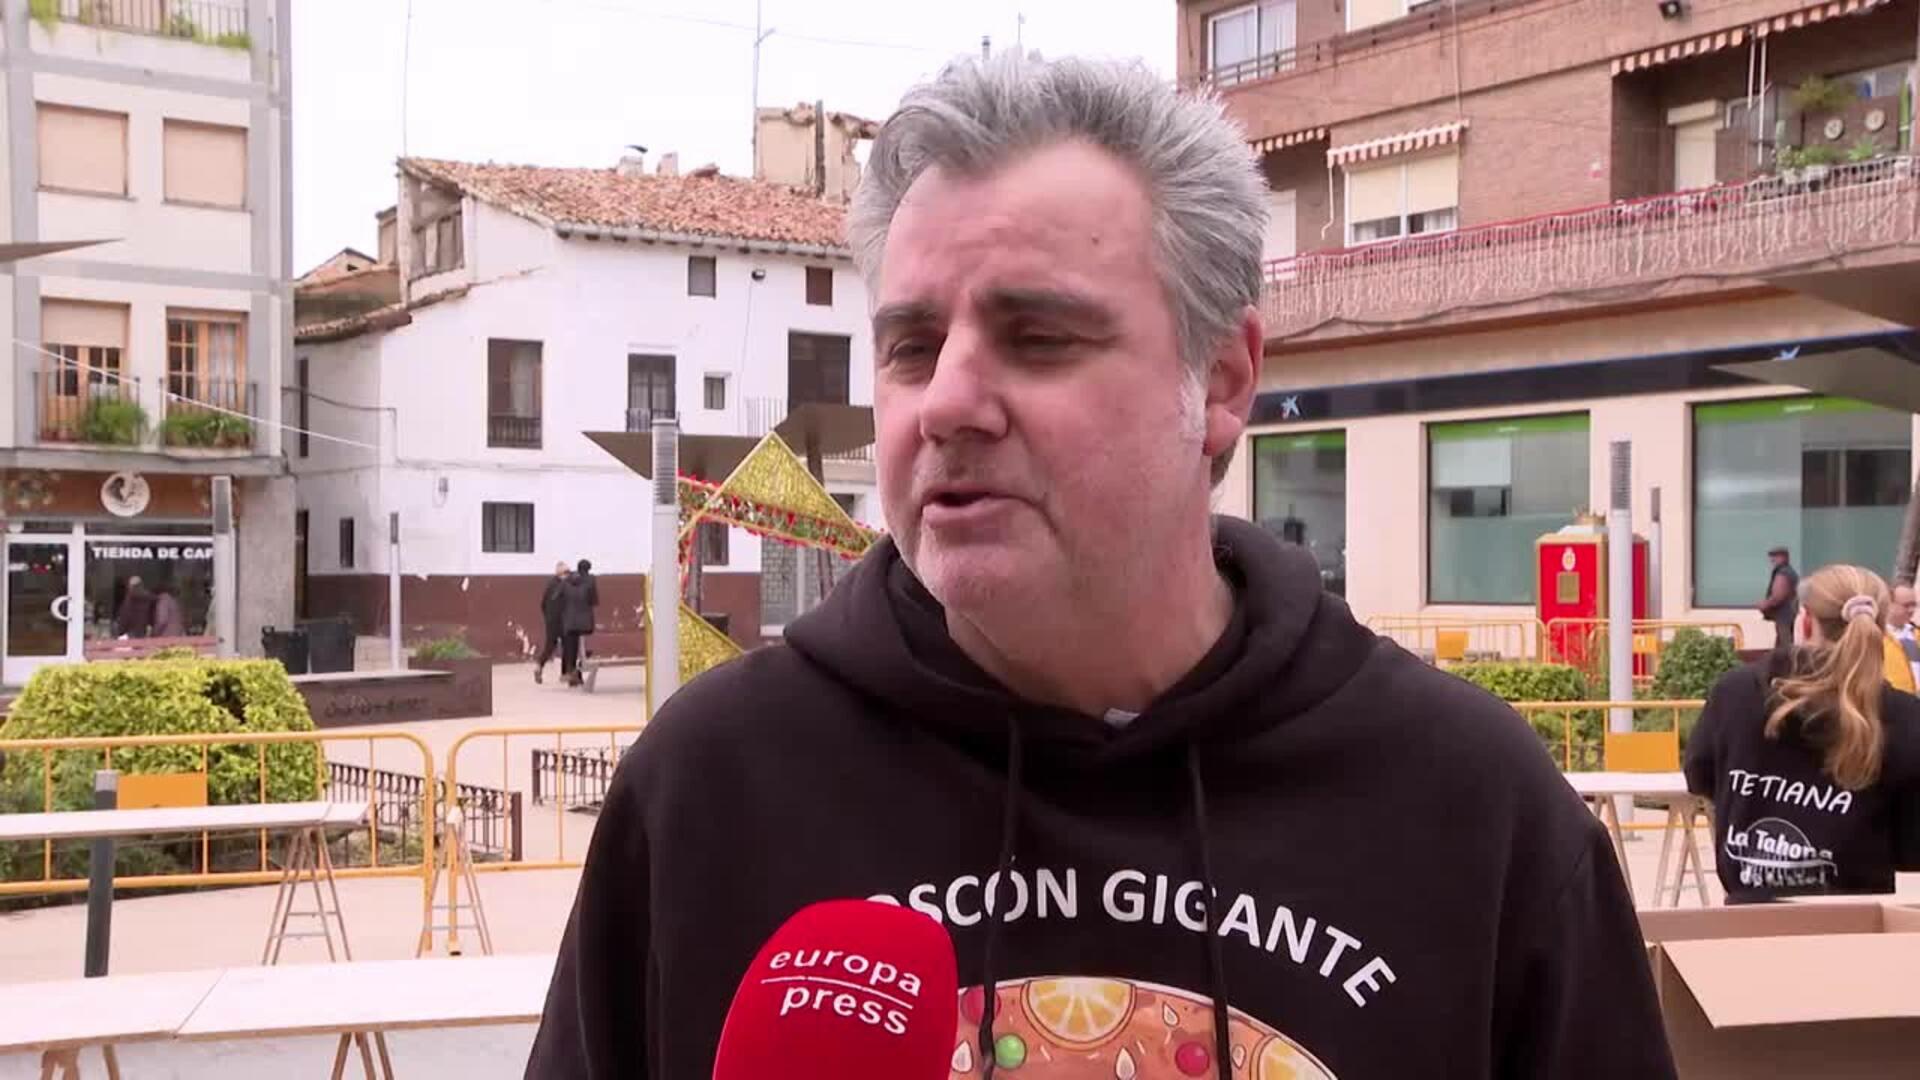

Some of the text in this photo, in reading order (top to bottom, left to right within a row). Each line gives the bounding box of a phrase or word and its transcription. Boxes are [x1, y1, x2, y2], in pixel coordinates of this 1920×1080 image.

[93, 546, 153, 559] TIENDA
[158, 547, 179, 559] DE
[1728, 769, 1853, 814] TETIANA
[1727, 824, 1748, 848] La
[1102, 869, 1397, 1007] GIGANTE
[769, 949, 922, 996] europa
[779, 986, 908, 1034] press
